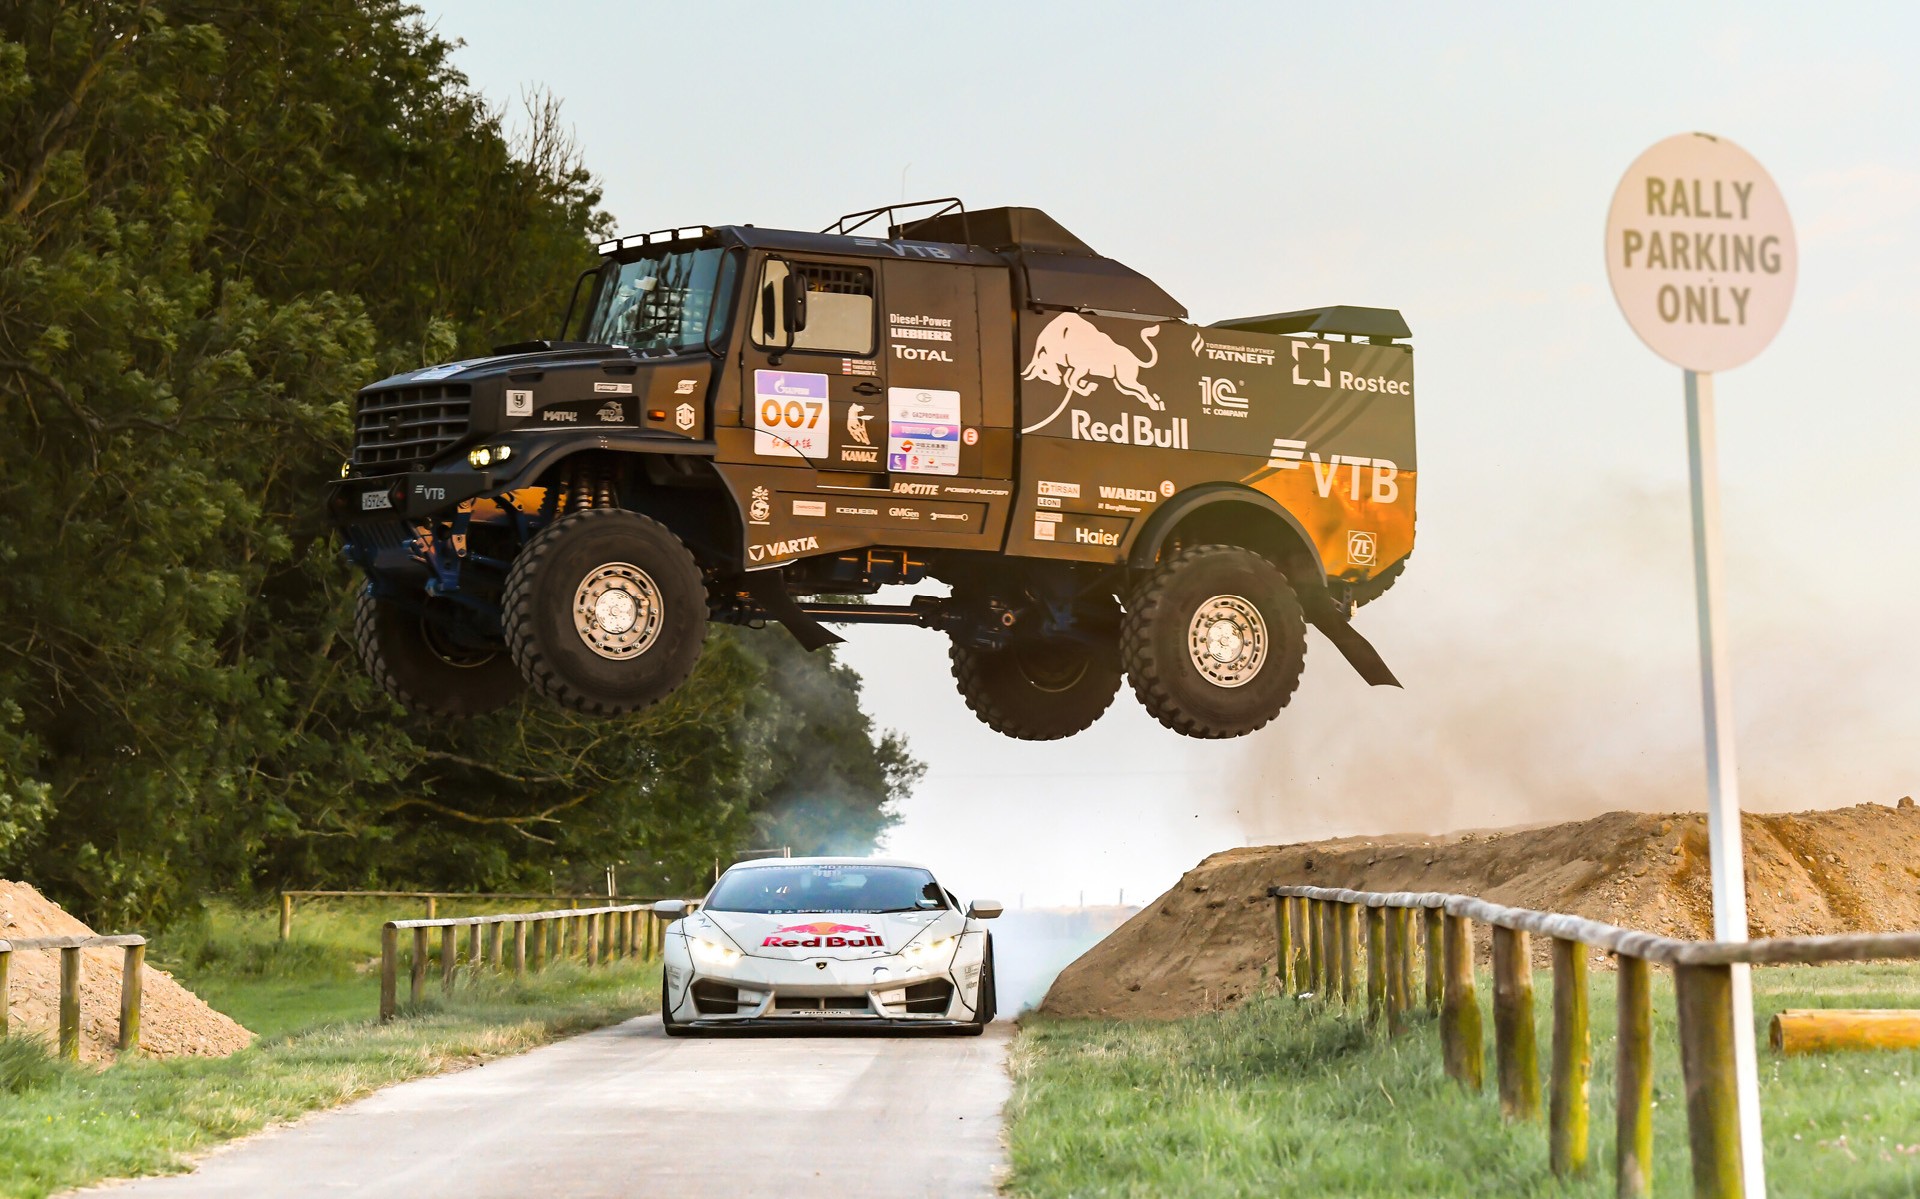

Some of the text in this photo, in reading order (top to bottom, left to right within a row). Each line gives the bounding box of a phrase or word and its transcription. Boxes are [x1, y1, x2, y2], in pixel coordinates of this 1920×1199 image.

[1646, 176, 1753, 220] RALLY
[881, 242, 951, 259] VTB
[1622, 229, 1782, 275] PARKING
[1657, 284, 1751, 326] ONLY
[890, 313, 952, 327] Diesel-Power
[891, 344, 954, 363] TOTAL
[1205, 349, 1276, 366] TATNEFT
[1340, 370, 1410, 396] Rostec
[761, 398, 823, 430] 007
[1213, 408, 1248, 418] COMPANY
[1071, 409, 1189, 450] Red Bull
[841, 450, 878, 463] KAMAZ
[1310, 452, 1399, 504] VTB
[424, 487, 445, 500] VTB
[893, 482, 940, 496] LOCTITE
[1099, 486, 1157, 503] WABCO
[1039, 498, 1060, 506] LEONI
[1075, 527, 1120, 546] Haier
[766, 537, 819, 557] VARTA
[761, 935, 885, 947] Red Bull
